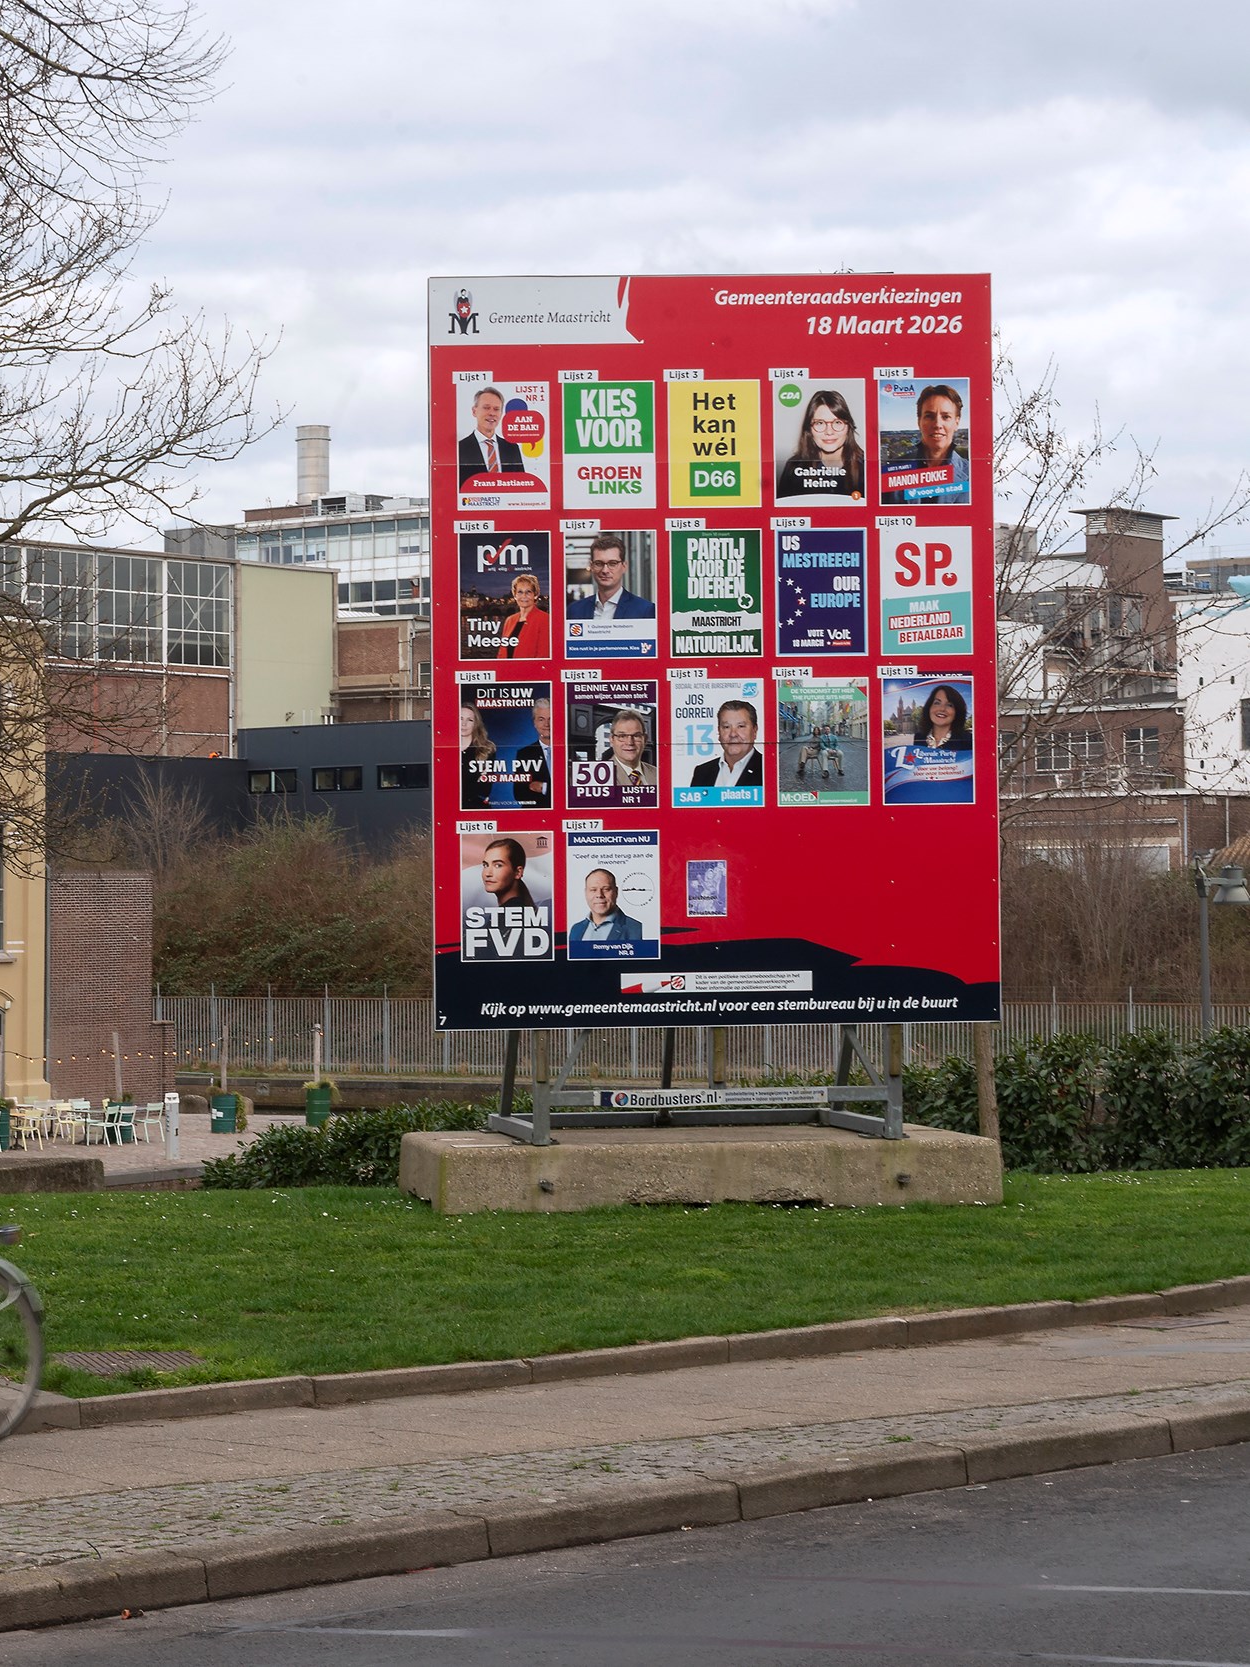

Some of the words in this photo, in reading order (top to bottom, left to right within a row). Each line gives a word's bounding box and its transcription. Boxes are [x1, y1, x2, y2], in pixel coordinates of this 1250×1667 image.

[714, 288, 962, 307] Gemeenteraadsverkiezingen
[489, 312, 544, 323] Gemeente
[547, 310, 611, 323] Maastricht
[806, 316, 832, 335] 18
[836, 315, 904, 335] Maart
[907, 315, 963, 334] 2026
[459, 373, 480, 382] Lijst
[564, 372, 584, 381] Lijst
[669, 371, 690, 379] Lijst
[774, 370, 795, 378] Lijst
[879, 369, 899, 377] Lijst
[693, 392, 736, 411] Het
[779, 392, 800, 400] CDA
[580, 388, 636, 418] KIES
[693, 415, 736, 433] kan
[575, 418, 642, 448] VOOR
[693, 436, 736, 456] wél
[577, 466, 642, 480] GROEN
[794, 466, 846, 476] Gabriëlle
[497, 479, 534, 487] Bastiaens
[694, 470, 736, 488] D66
[803, 479, 838, 488] Heine
[888, 473, 918, 487] MANON
[920, 470, 947, 483] FOKKE
[589, 481, 642, 494] LINKS
[946, 484, 963, 492] stad
[460, 523, 480, 531] Lijst
[566, 521, 586, 530] Lijst
[671, 520, 692, 528] Lijst
[776, 519, 797, 527] Lijst
[879, 518, 899, 526] Lijst
[687, 538, 745, 560] PARTIJ
[782, 536, 800, 551] US
[782, 552, 859, 568] MESTREECH
[687, 560, 724, 577] VOOR
[727, 560, 745, 577] DE
[687, 577, 745, 599] DIEREN
[833, 576, 860, 591] OUR
[810, 593, 861, 608] EUROPE
[910, 600, 939, 613] MAAK
[467, 618, 501, 634] Tiny
[692, 616, 741, 627] MAASTRICHT
[890, 613, 950, 629] NEDERLAND
[807, 629, 824, 637] VOTE
[827, 629, 851, 639] Volt
[900, 627, 963, 643] BETAALBAAR
[468, 635, 519, 647] Meese
[676, 635, 758, 653] NATUURLIJK.
[792, 639, 800, 647] 18
[801, 639, 824, 647] MARCH
[460, 673, 481, 681] Lijst
[565, 672, 585, 680] Lijst
[671, 670, 691, 678] Lijst
[776, 669, 796, 677] Lijst
[881, 668, 901, 676] Lijst
[477, 688, 496, 699] DIT
[500, 688, 509, 698] IS
[511, 688, 533, 698] UW
[477, 699, 535, 707] MAASTRICHT!
[685, 694, 704, 705] JOS
[676, 708, 713, 718] GORREN
[685, 725, 714, 756] 13
[469, 760, 507, 773] STEM
[512, 760, 543, 772] PVV
[500, 774, 531, 782] MAART
[576, 762, 611, 785] 50
[576, 787, 610, 797] PLUS
[680, 791, 702, 802] SAB
[721, 790, 751, 801] plaats
[753, 789, 758, 800] 1
[460, 822, 480, 832] Lijst
[484, 822, 493, 830] 16
[566, 821, 586, 831] Lijst
[590, 821, 599, 829] 17
[465, 906, 548, 928] STEM
[466, 928, 550, 957] FVD
[481, 1003, 506, 1017] Kijk
[509, 1004, 526, 1017] op
[528, 1000, 716, 1016] www.gemeentemaastricht.nl
[719, 1002, 749, 1012] voor
[751, 1000, 774, 1011] een
[777, 998, 856, 1010] stembureau
[858, 997, 875, 1012] bij
[877, 1000, 885, 1009] u
[887, 997, 900, 1009] in
[903, 997, 919, 1009] de
[921, 997, 958, 1009] buurt
[439, 1016, 446, 1026] 7
